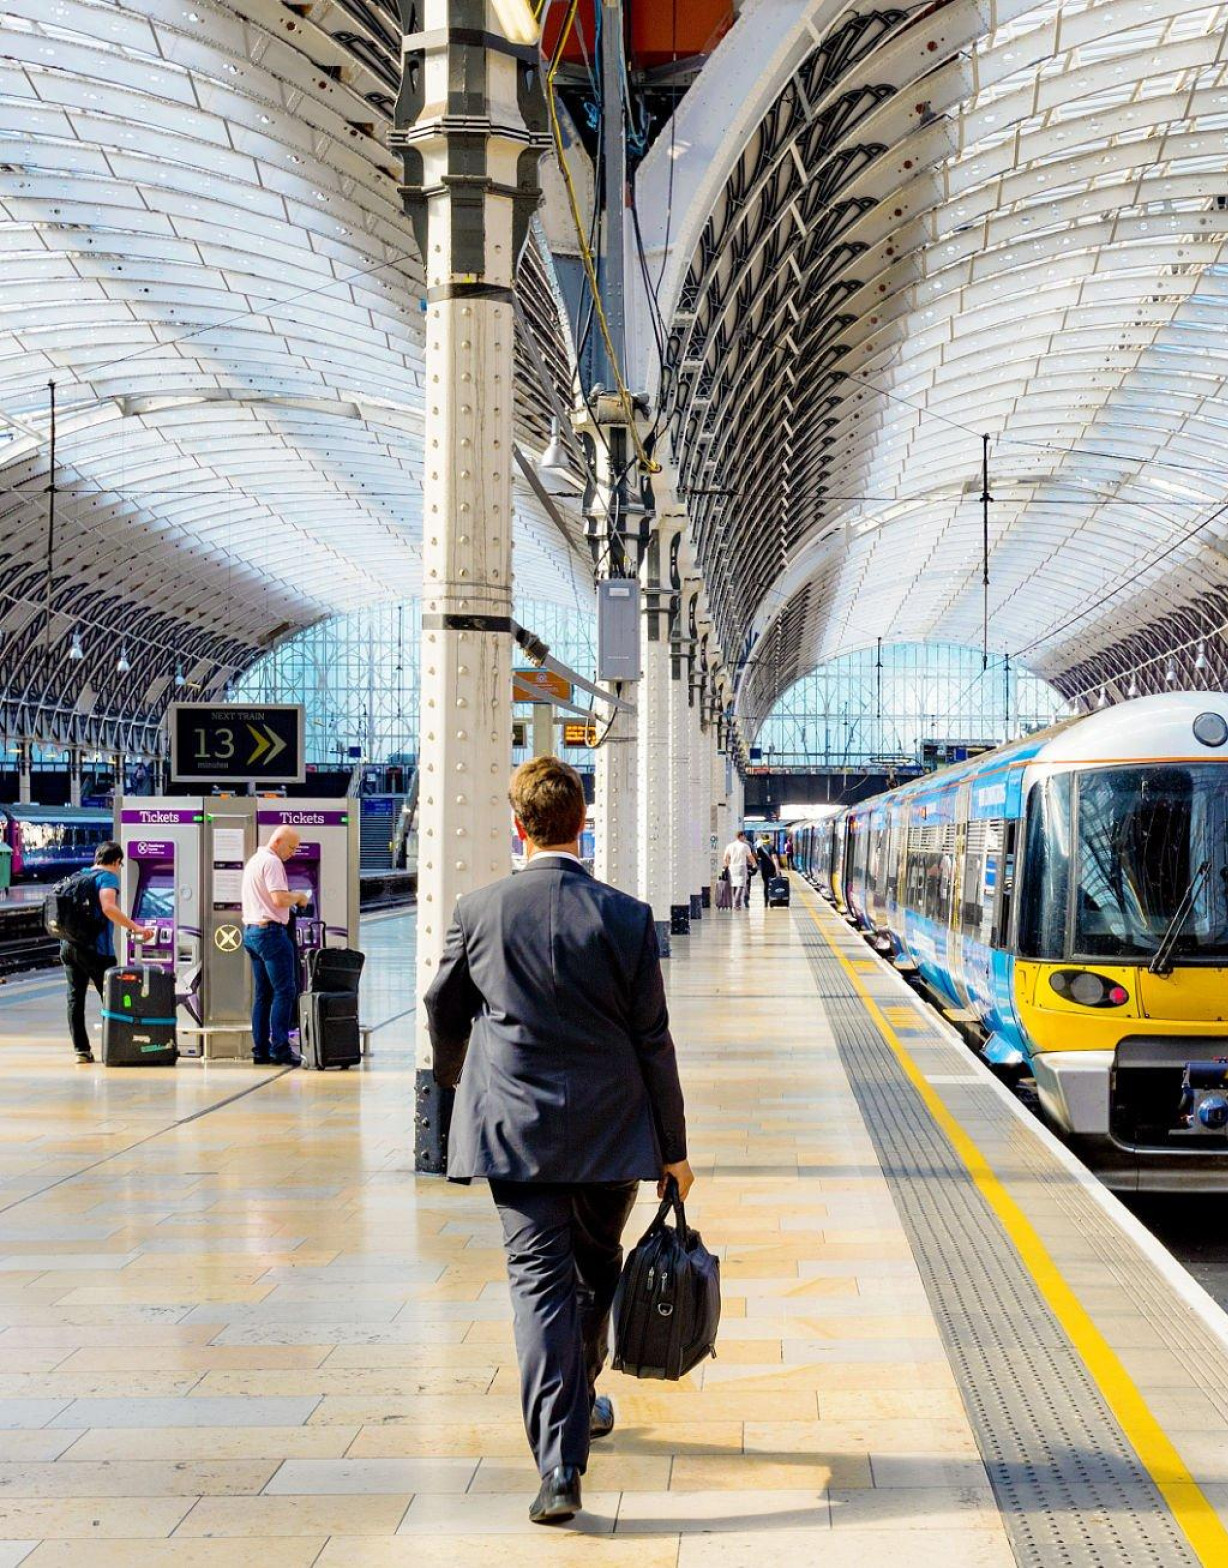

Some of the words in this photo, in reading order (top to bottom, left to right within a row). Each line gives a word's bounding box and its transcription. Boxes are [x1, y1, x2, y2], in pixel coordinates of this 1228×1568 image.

[211, 712, 236, 720] NEXT
[238, 712, 265, 720] TRAIN
[193, 728, 235, 759] 13
[139, 811, 180, 824] Tickets
[279, 812, 325, 824] Tickets
